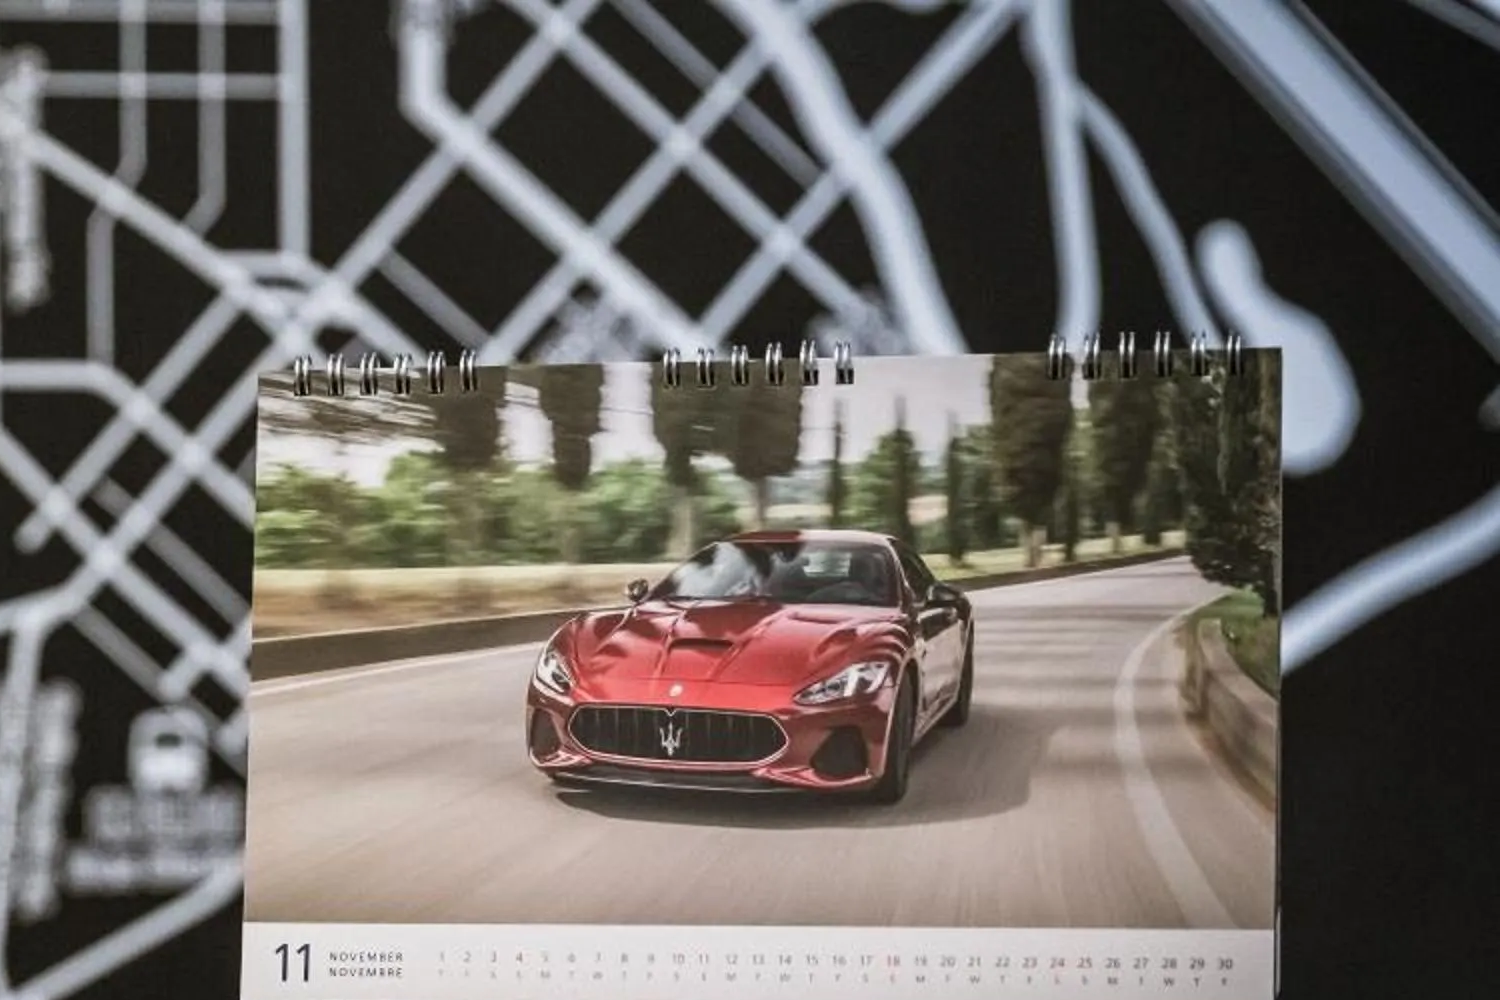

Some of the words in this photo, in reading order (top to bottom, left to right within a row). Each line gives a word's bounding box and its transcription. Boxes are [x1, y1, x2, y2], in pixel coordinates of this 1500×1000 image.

[275, 943, 311, 982] 11
[329, 951, 404, 962] NOVEMBER
[673, 953, 685, 964] 10
[699, 953, 709, 964] 11
[726, 953, 738, 965] 12
[779, 954, 792, 965] 14
[833, 955, 847, 966] 16
[860, 955, 873, 967] 17
[887, 955, 901, 967] 18
[940, 956, 956, 967] 20
[968, 956, 981, 967] 21
[995, 957, 1010, 967] 22
[1022, 957, 1038, 968] 23
[1050, 958, 1065, 969] 24
[1077, 958, 1092, 968] 25
[1105, 958, 1120, 969] 26
[1133, 957, 1149, 969] 27
[1161, 958, 1177, 969] 28
[1189, 958, 1205, 970] 29
[1218, 958, 1233, 970] 30
[329, 967, 404, 978] NOVEMBRE
